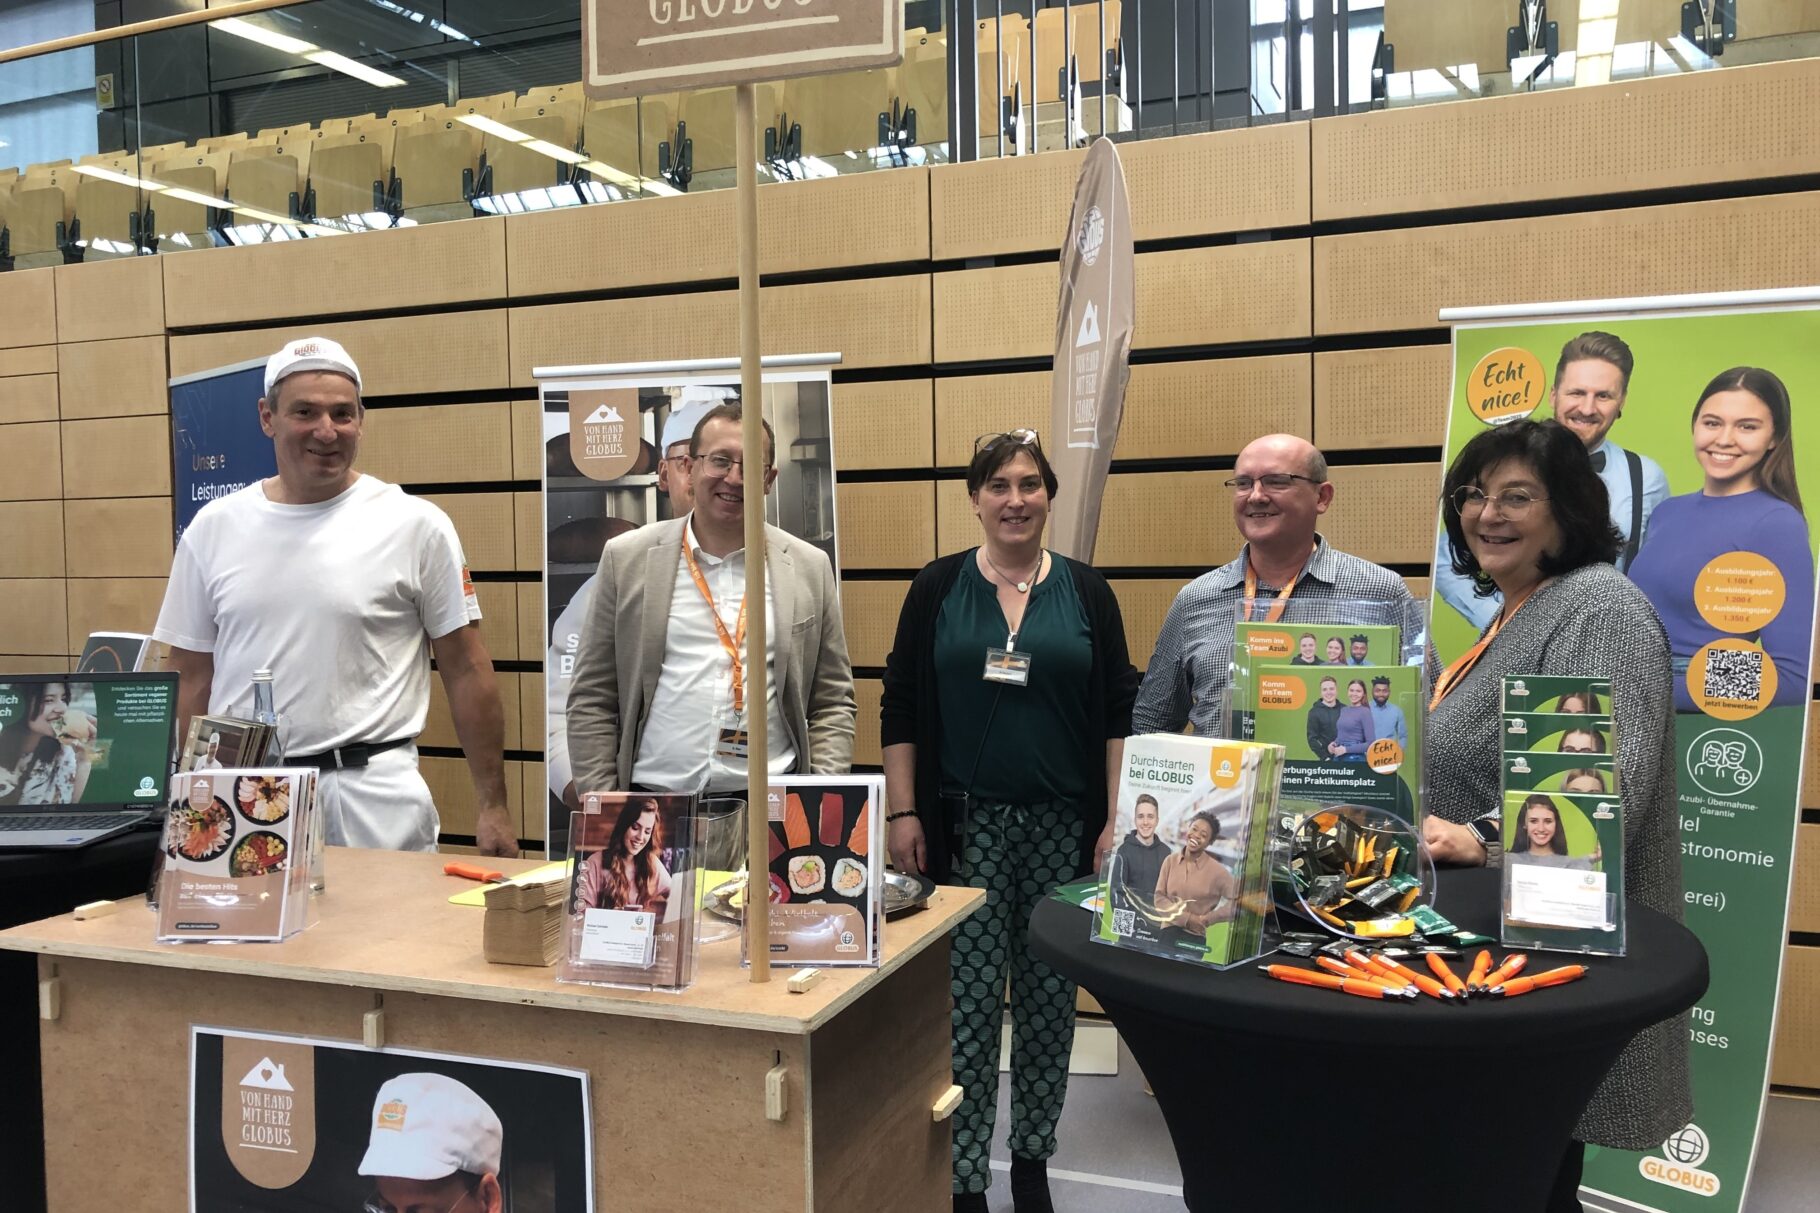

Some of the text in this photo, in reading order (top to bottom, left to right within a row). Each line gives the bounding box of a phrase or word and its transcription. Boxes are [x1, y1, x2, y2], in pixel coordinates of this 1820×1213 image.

[1483, 360, 1526, 388] Echt
[1481, 380, 1531, 411] nice!
[584, 424, 624, 435] VON HAND
[586, 433, 622, 444] MIT HERZ
[586, 443, 623, 455] GLOBUS
[192, 453, 226, 471] Unsere
[1250, 636, 1272, 644] Komm
[1262, 680, 1286, 688] Komm
[1262, 696, 1292, 704] GLOBUS
[1722, 701, 1758, 710] bewerben
[1373, 742, 1393, 754] Echt
[1130, 754, 1195, 771] Durchstarten
[1373, 752, 1397, 766] nice!
[1129, 766, 1194, 785] bei GLOBUS
[1304, 776, 1376, 788] Praktikumsplatz
[1679, 794, 1759, 811] Azubi- Übernahme-
[1700, 806, 1736, 818] Garantie
[180, 882, 194, 890] Die
[1684, 890, 1726, 913] erei)
[1692, 1006, 1715, 1025] ng
[240, 1090, 293, 1111] VON HAND
[242, 1106, 291, 1126] MIT HERZ
[242, 1124, 292, 1146] GLOBUS
[1643, 1161, 1716, 1193] GLOBUS
